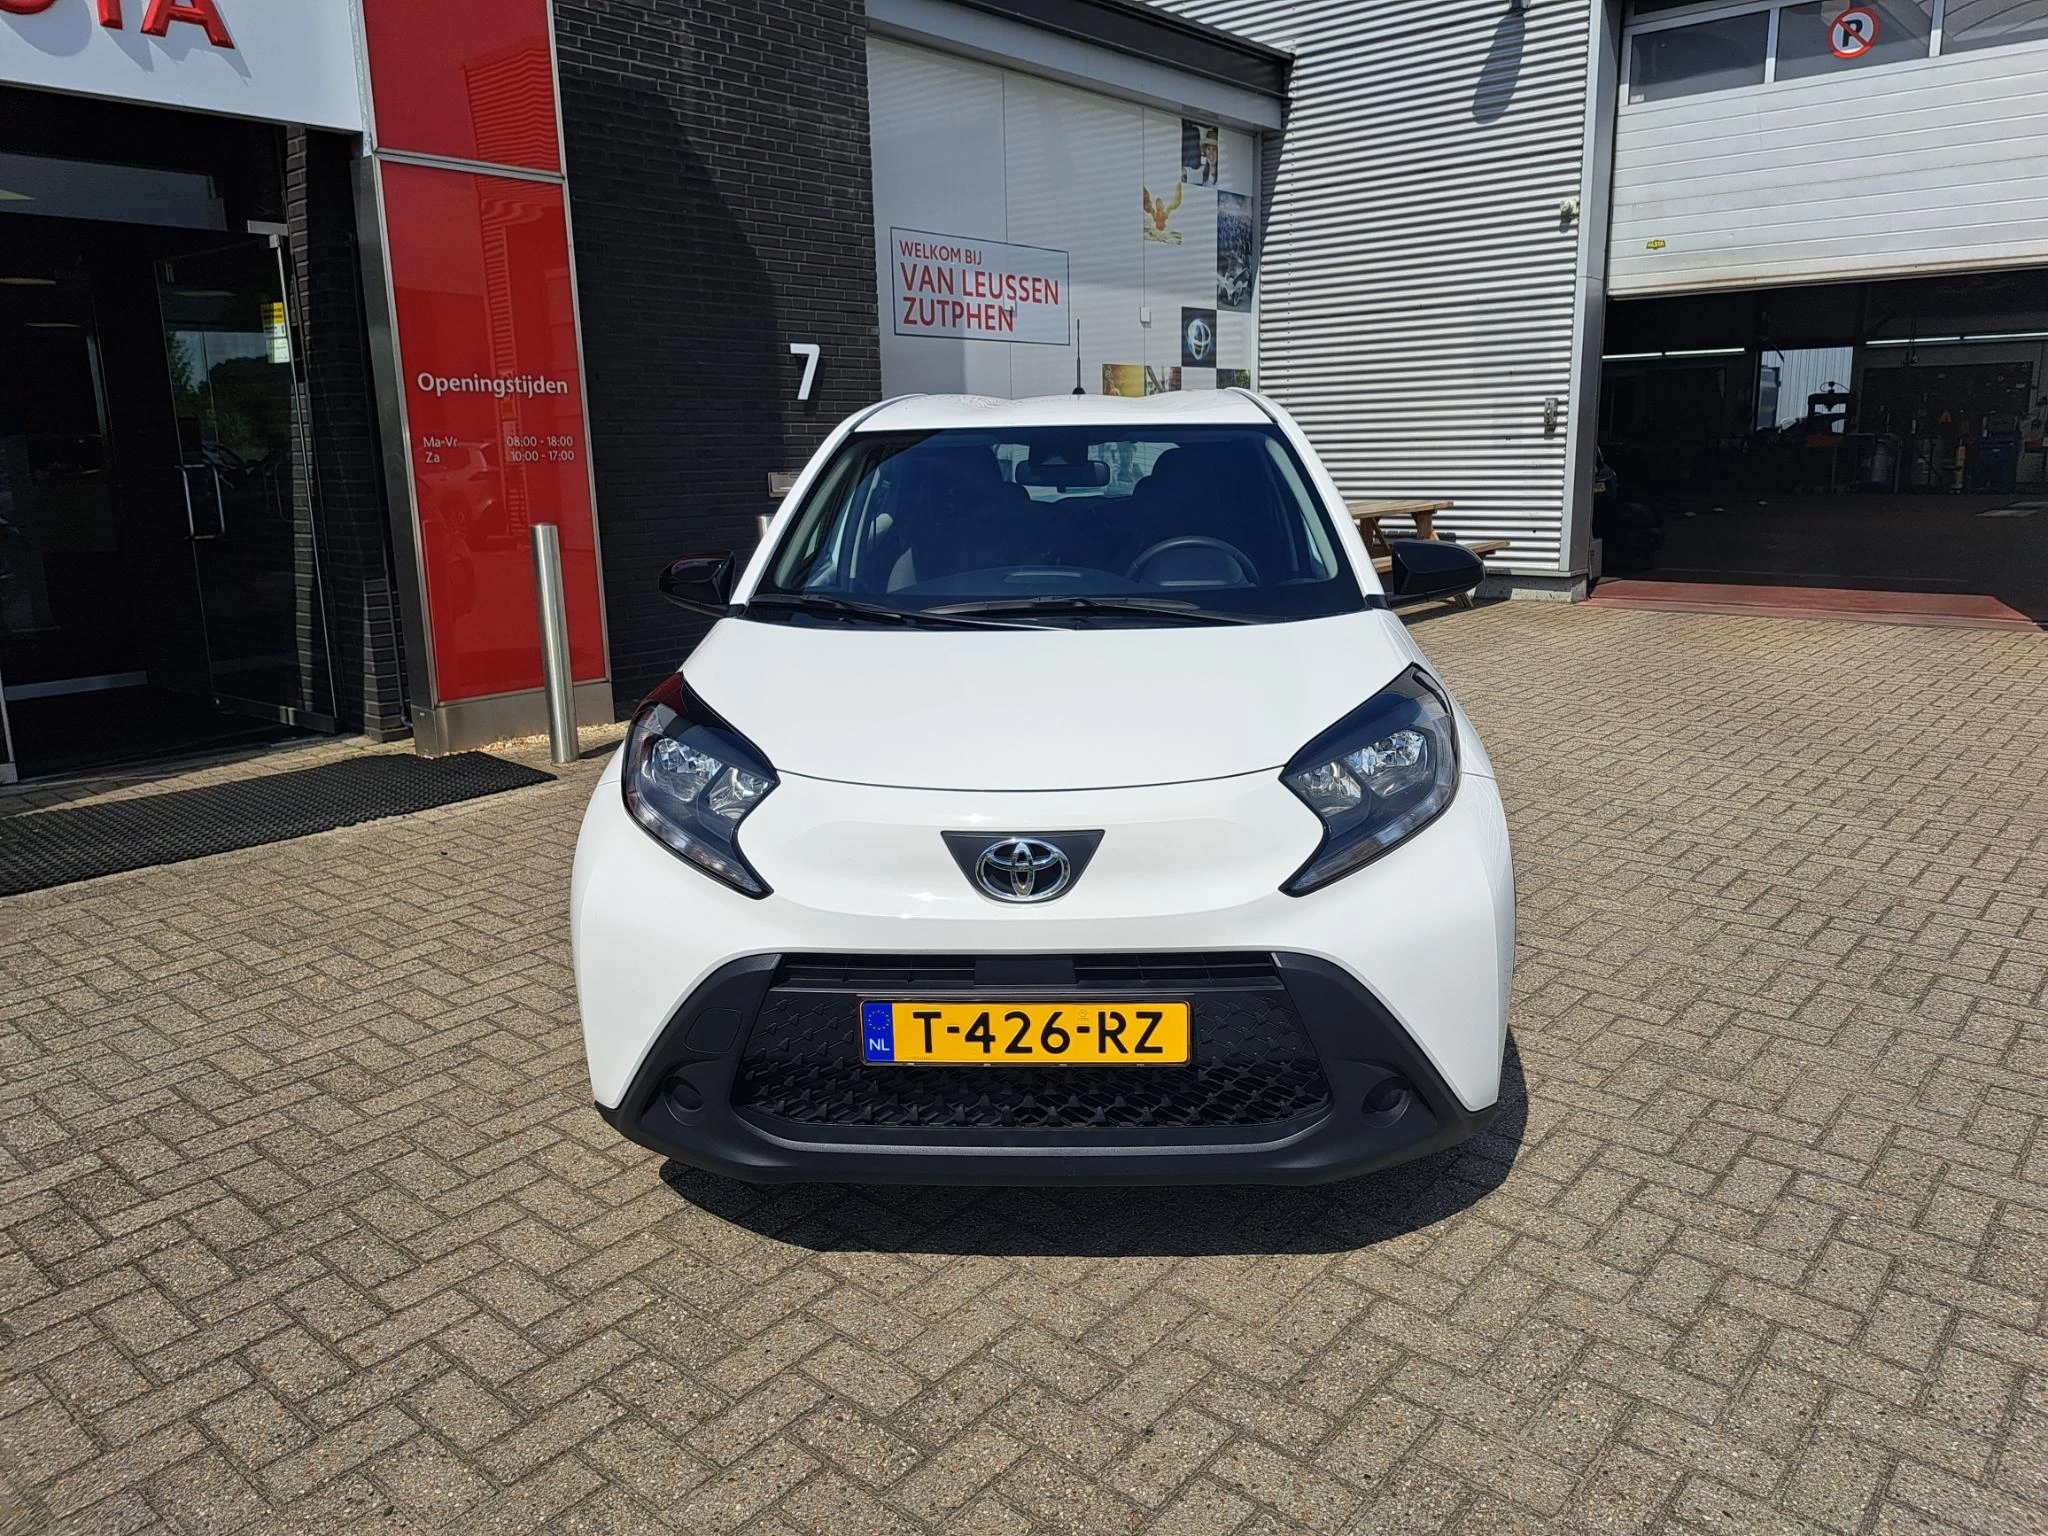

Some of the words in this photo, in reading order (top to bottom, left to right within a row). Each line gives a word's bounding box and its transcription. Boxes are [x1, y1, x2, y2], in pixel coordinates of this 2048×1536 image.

[899, 240, 962, 263] WELKOM
[965, 249, 982, 265] BIJ
[900, 262, 954, 295] VAN
[962, 269, 1059, 305] LEUSSEN
[903, 296, 1014, 332] ZUTPHEN
[417, 372, 568, 398] Openingstijden
[790, 343, 820, 400] 7
[423, 435, 458, 448] Ma-Vr
[506, 435, 537, 447] 08:00
[547, 436, 573, 447] 18:00
[426, 451, 440, 463] Za
[511, 450, 539, 462] 10:00
[549, 450, 575, 462] 17:00
[869, 1038, 890, 1051] NL
[912, 1011, 1164, 1054] T-426-RZ
